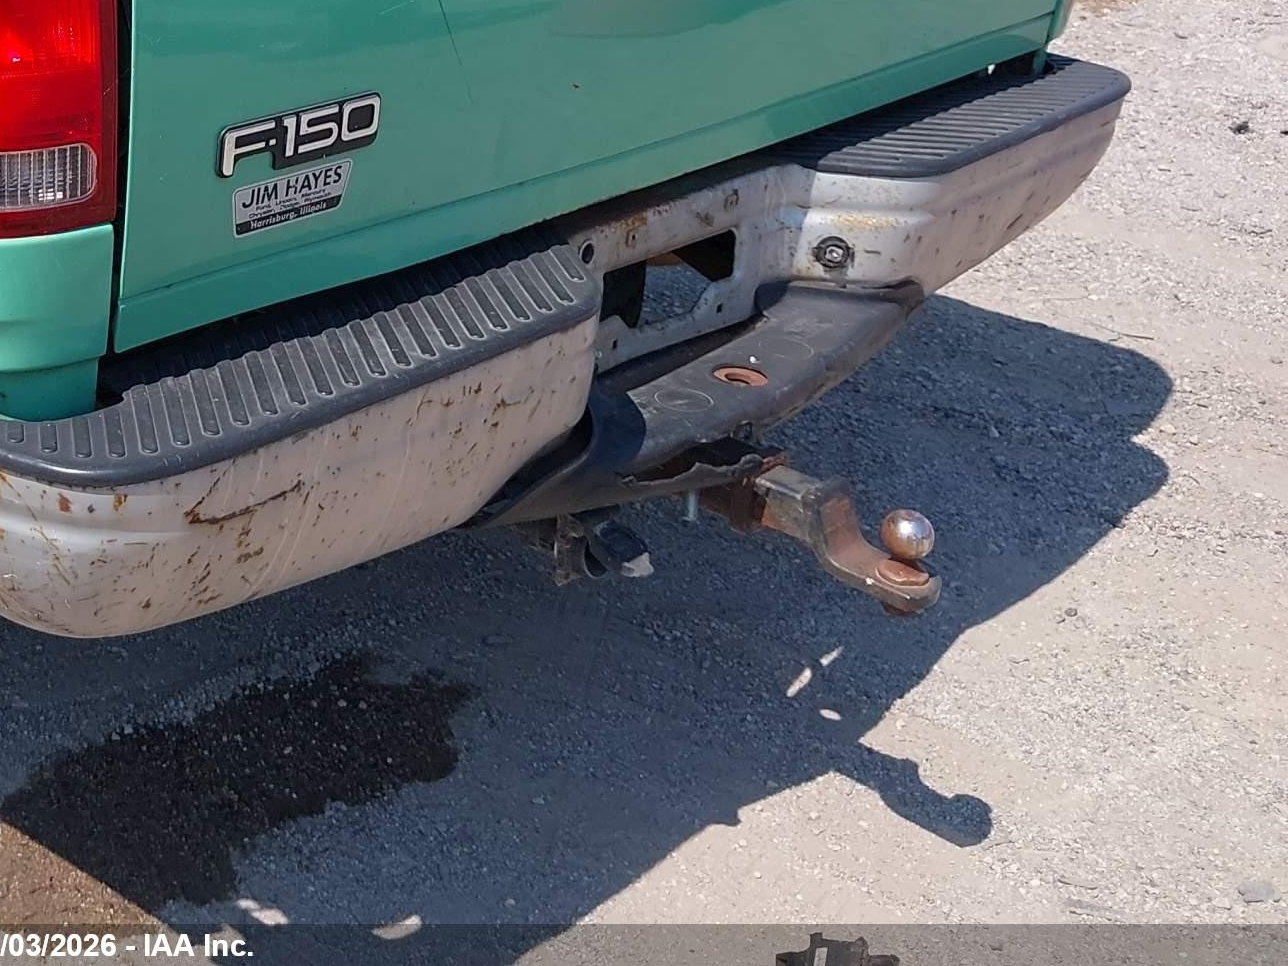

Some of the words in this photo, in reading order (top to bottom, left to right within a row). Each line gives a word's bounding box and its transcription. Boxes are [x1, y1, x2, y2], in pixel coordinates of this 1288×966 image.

[222, 95, 381, 177] F-150
[242, 183, 279, 209] JIM
[285, 165, 343, 197] HAYES
[300, 201, 327, 215] Illinois
